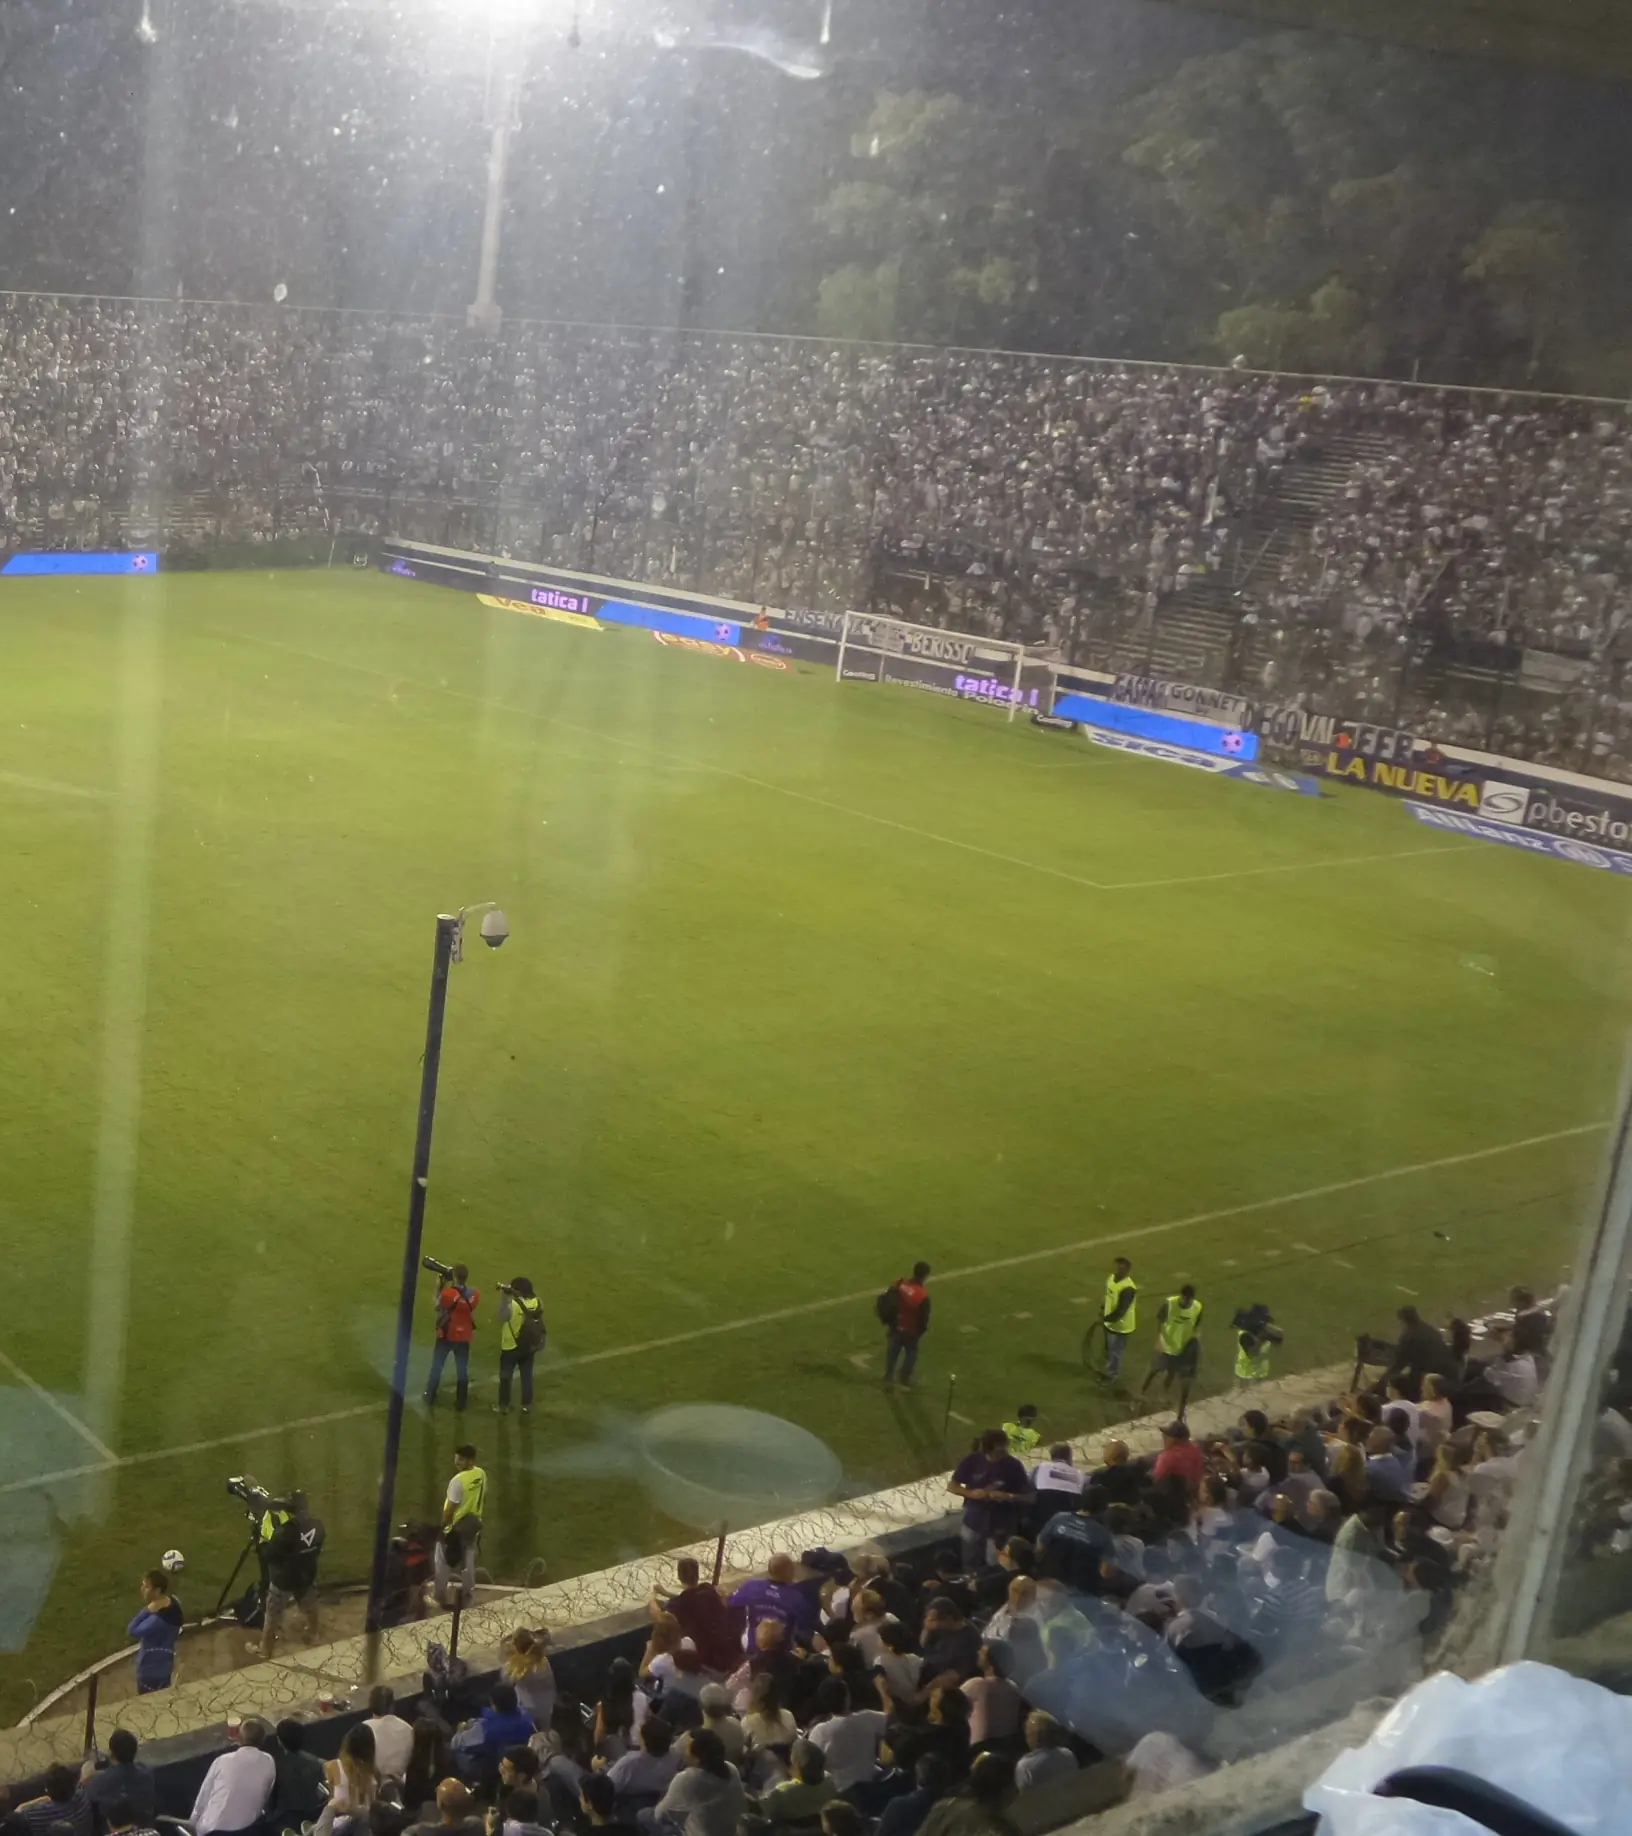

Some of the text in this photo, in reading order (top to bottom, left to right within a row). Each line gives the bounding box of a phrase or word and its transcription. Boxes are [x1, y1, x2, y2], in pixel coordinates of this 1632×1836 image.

[531, 588, 578, 611] tatica
[955, 674, 1023, 702] tatica
[1326, 751, 1366, 780] LA
[1373, 761, 1481, 808] NUEVA
[1415, 806, 1552, 852] Allianz
